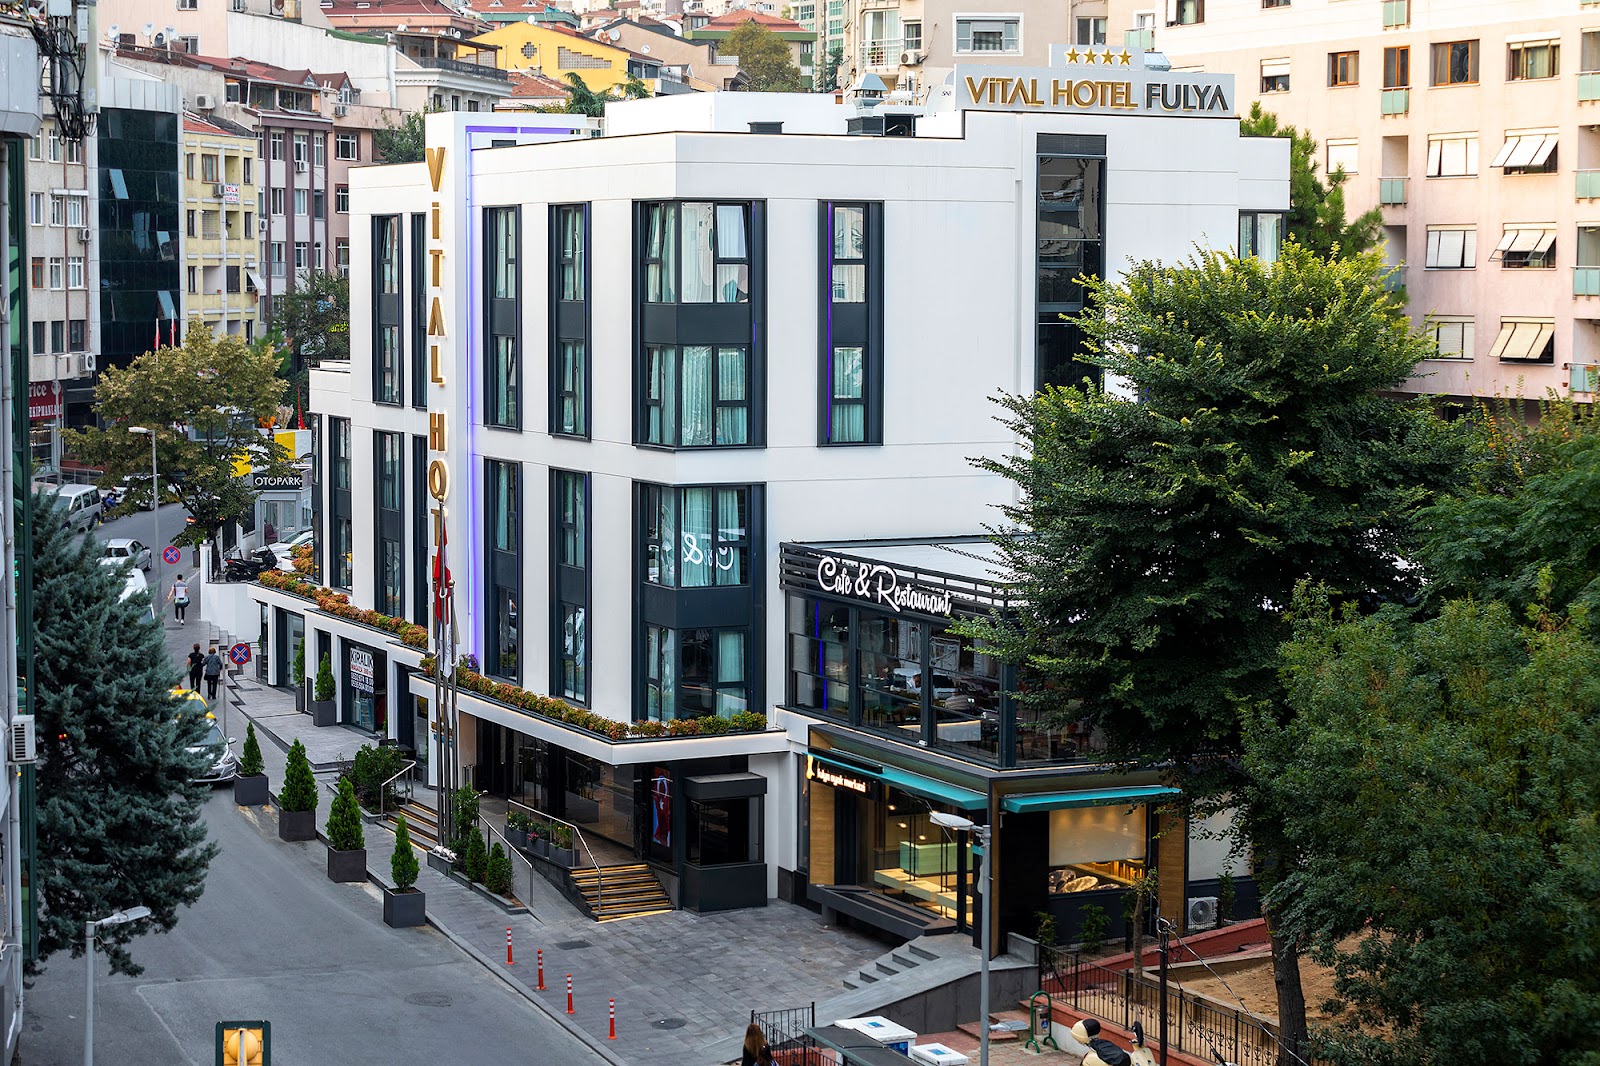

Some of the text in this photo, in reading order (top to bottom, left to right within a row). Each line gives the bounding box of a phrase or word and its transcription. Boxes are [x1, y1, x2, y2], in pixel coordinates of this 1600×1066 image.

[1052, 79, 1139, 109] HOTEL
[1146, 82, 1229, 112] FULYA
[254, 476, 301, 486] OTOPARK
[817, 556, 952, 615] Cafe & Restaurant
